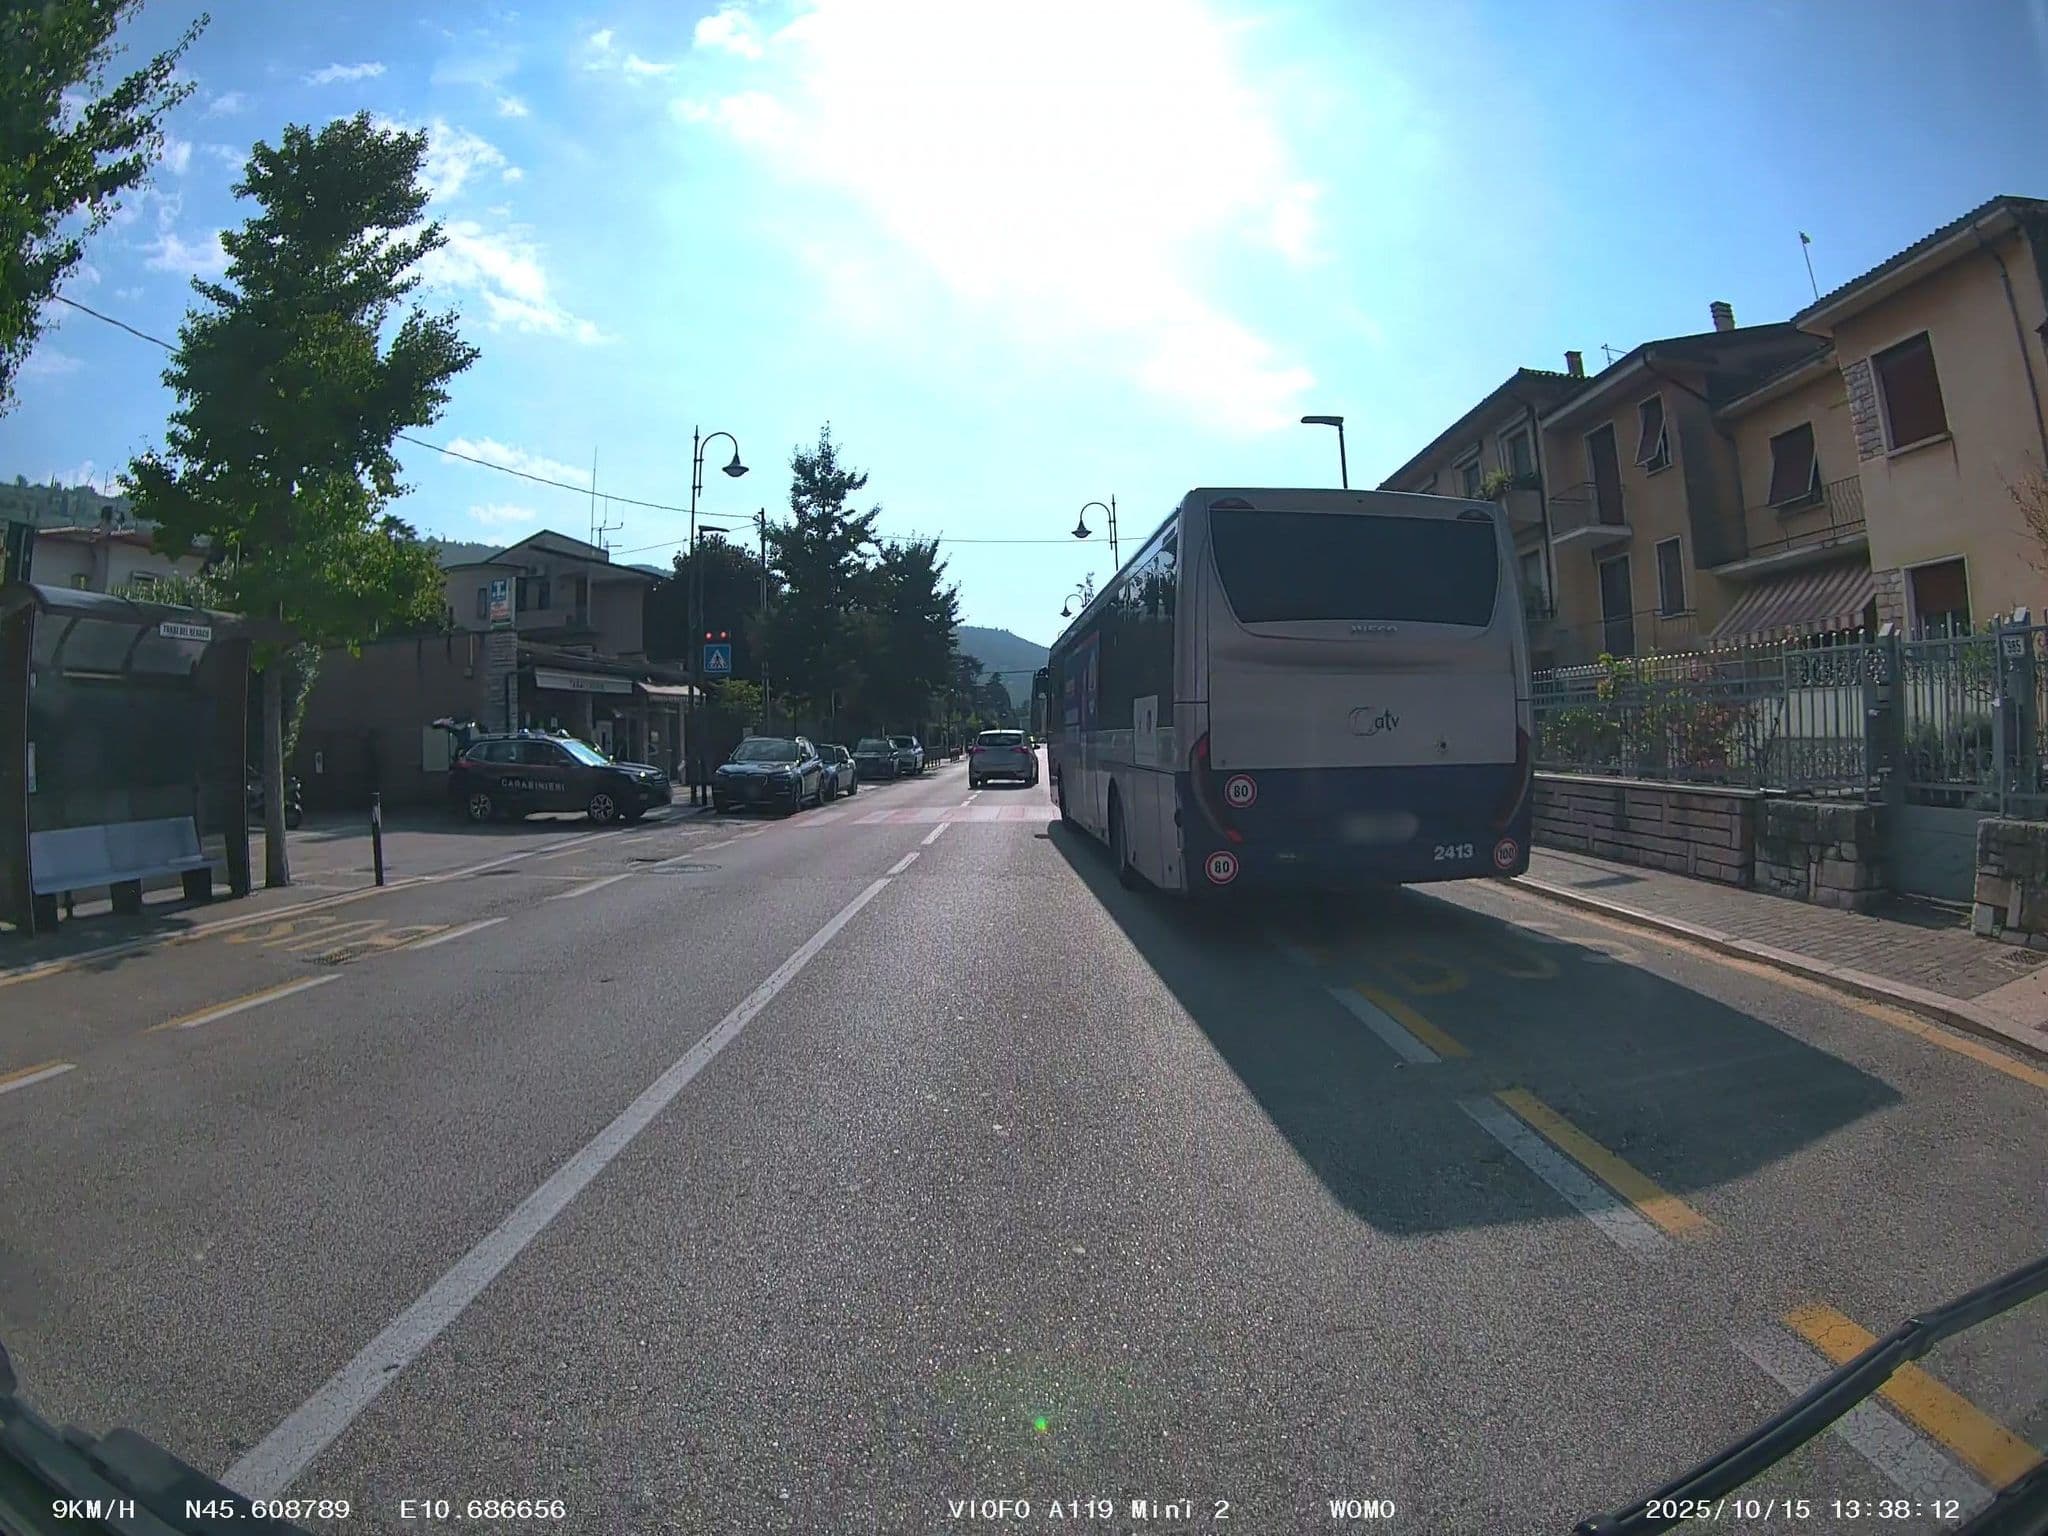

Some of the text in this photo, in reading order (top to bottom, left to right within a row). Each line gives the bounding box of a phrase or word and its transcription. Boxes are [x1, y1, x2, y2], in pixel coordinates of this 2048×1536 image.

[501, 779, 566, 792] CARABINIERI
[1233, 785, 1248, 797] 80
[1434, 843, 1473, 860] 2413
[1500, 847, 1516, 859] 100
[1214, 861, 1230, 873] 80
